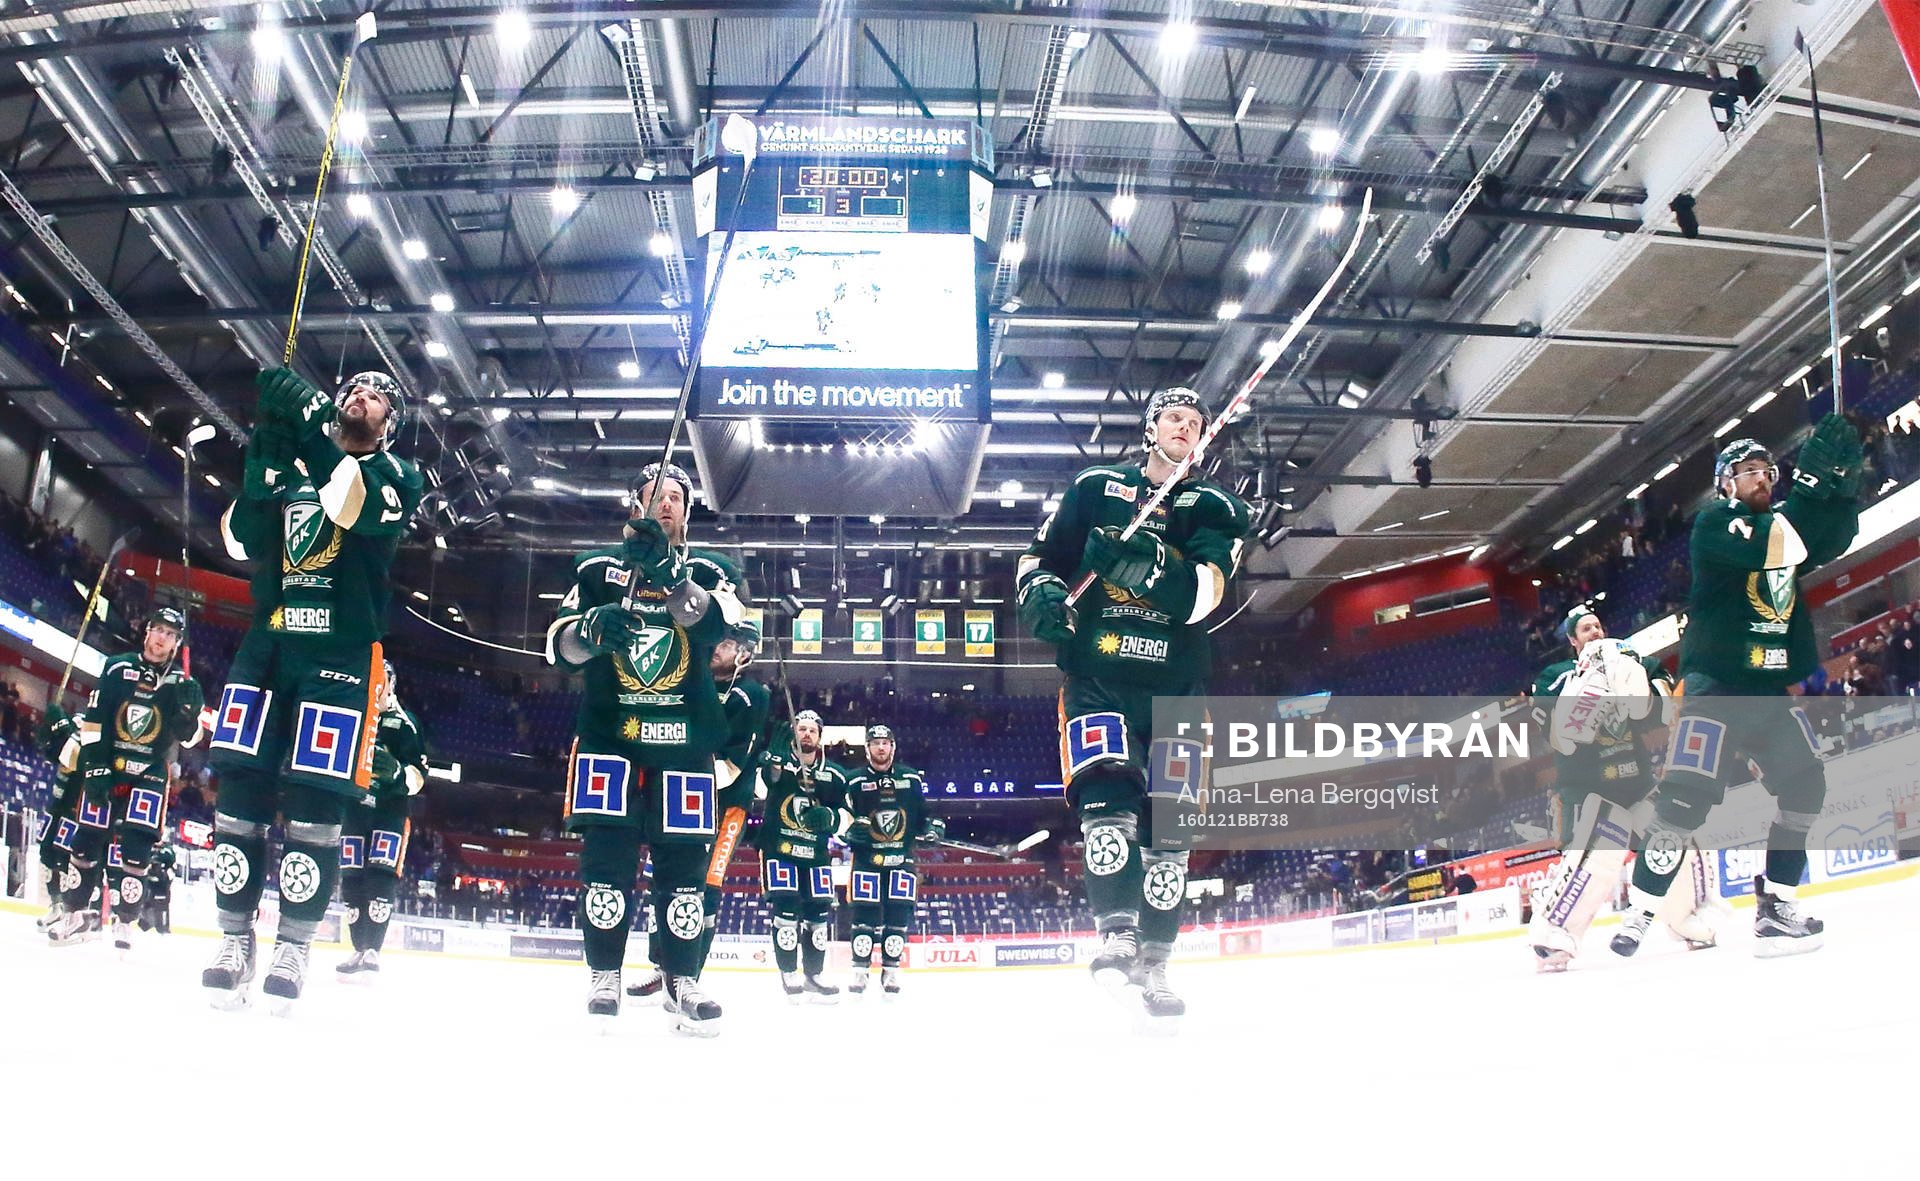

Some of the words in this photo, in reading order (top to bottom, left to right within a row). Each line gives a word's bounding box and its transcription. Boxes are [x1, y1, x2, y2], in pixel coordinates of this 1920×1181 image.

[759, 122, 966, 145] VÄRMLANDSCHARK
[810, 169, 878, 185] 20:00
[718, 379, 767, 405] Join
[773, 380, 817, 406] the
[822, 383, 965, 409] movement
[285, 607, 331, 628] ENERGI
[860, 623, 876, 641] 2
[923, 622, 938, 641] 9
[970, 624, 990, 642] 17
[1120, 635, 1169, 658] ENERGI
[319, 669, 361, 685] CCM
[641, 721, 687, 740] ENERGI
[946, 782, 957, 793] &
[974, 782, 1015, 793] BAR
[928, 950, 977, 963] JULA
[997, 948, 1056, 961] SWEDWISE
